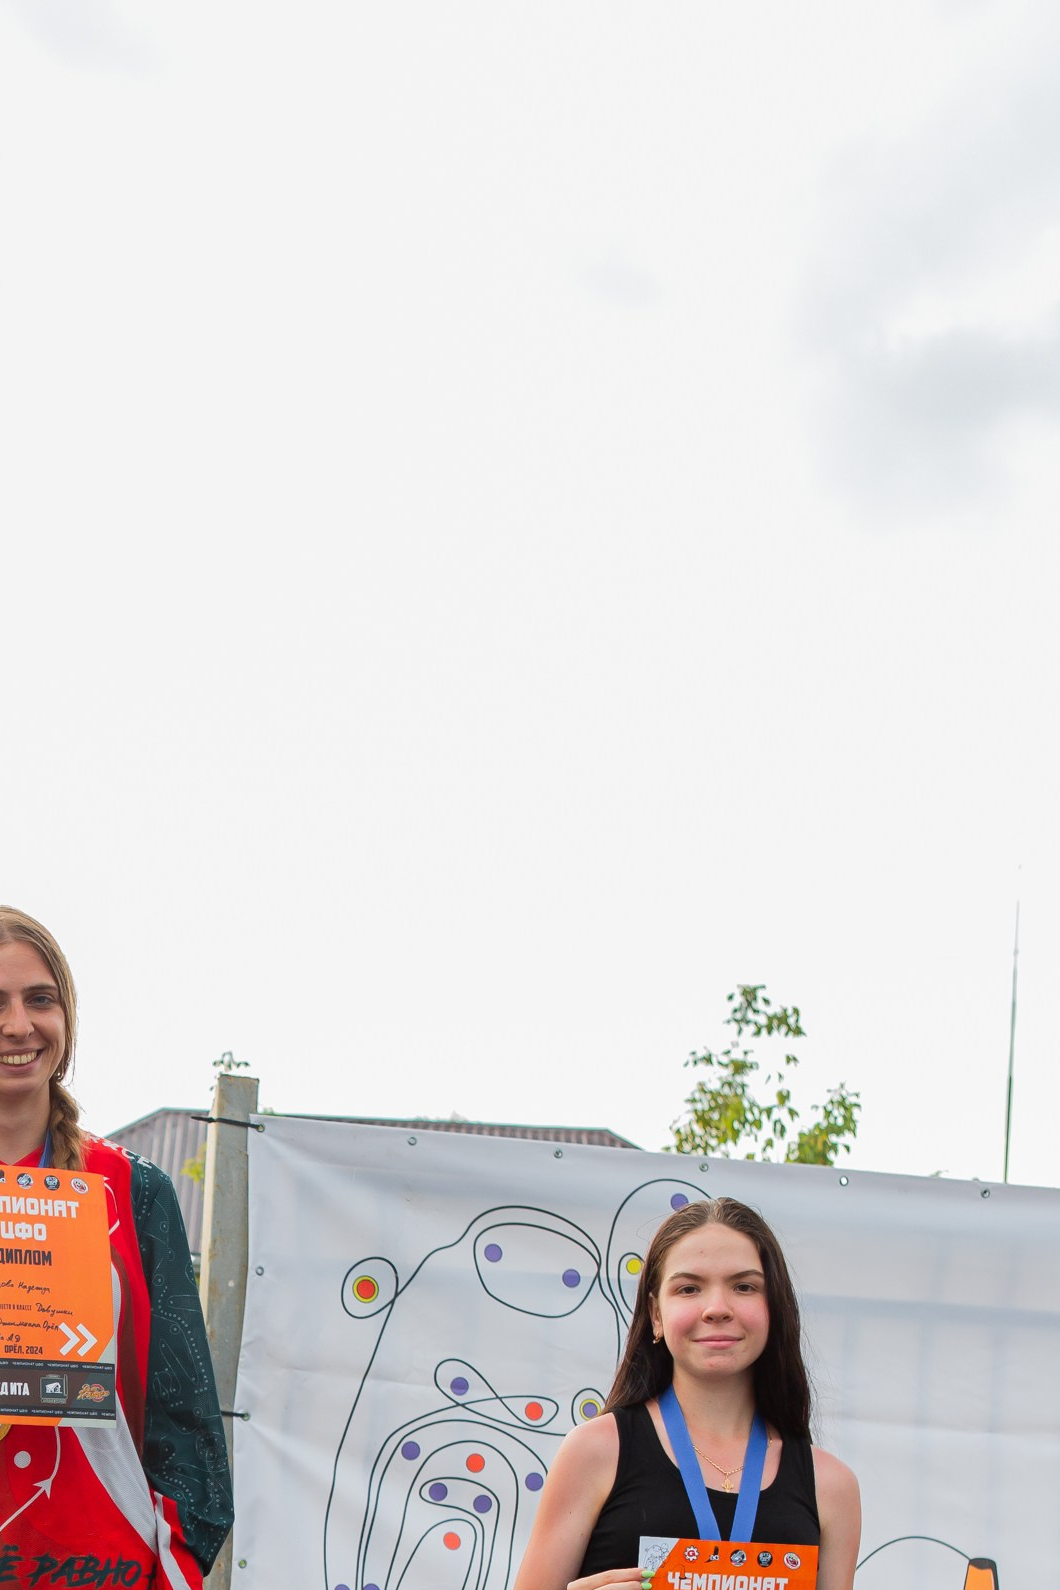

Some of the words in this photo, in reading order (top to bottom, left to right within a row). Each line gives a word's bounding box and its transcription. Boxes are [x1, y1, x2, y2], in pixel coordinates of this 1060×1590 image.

[0, 1221, 47, 1241] ЦФО
[25, 1346, 43, 1355] 2024
[10, 1382, 30, 1396] ИТА
[26, 1552, 142, 1590] РАВНО
